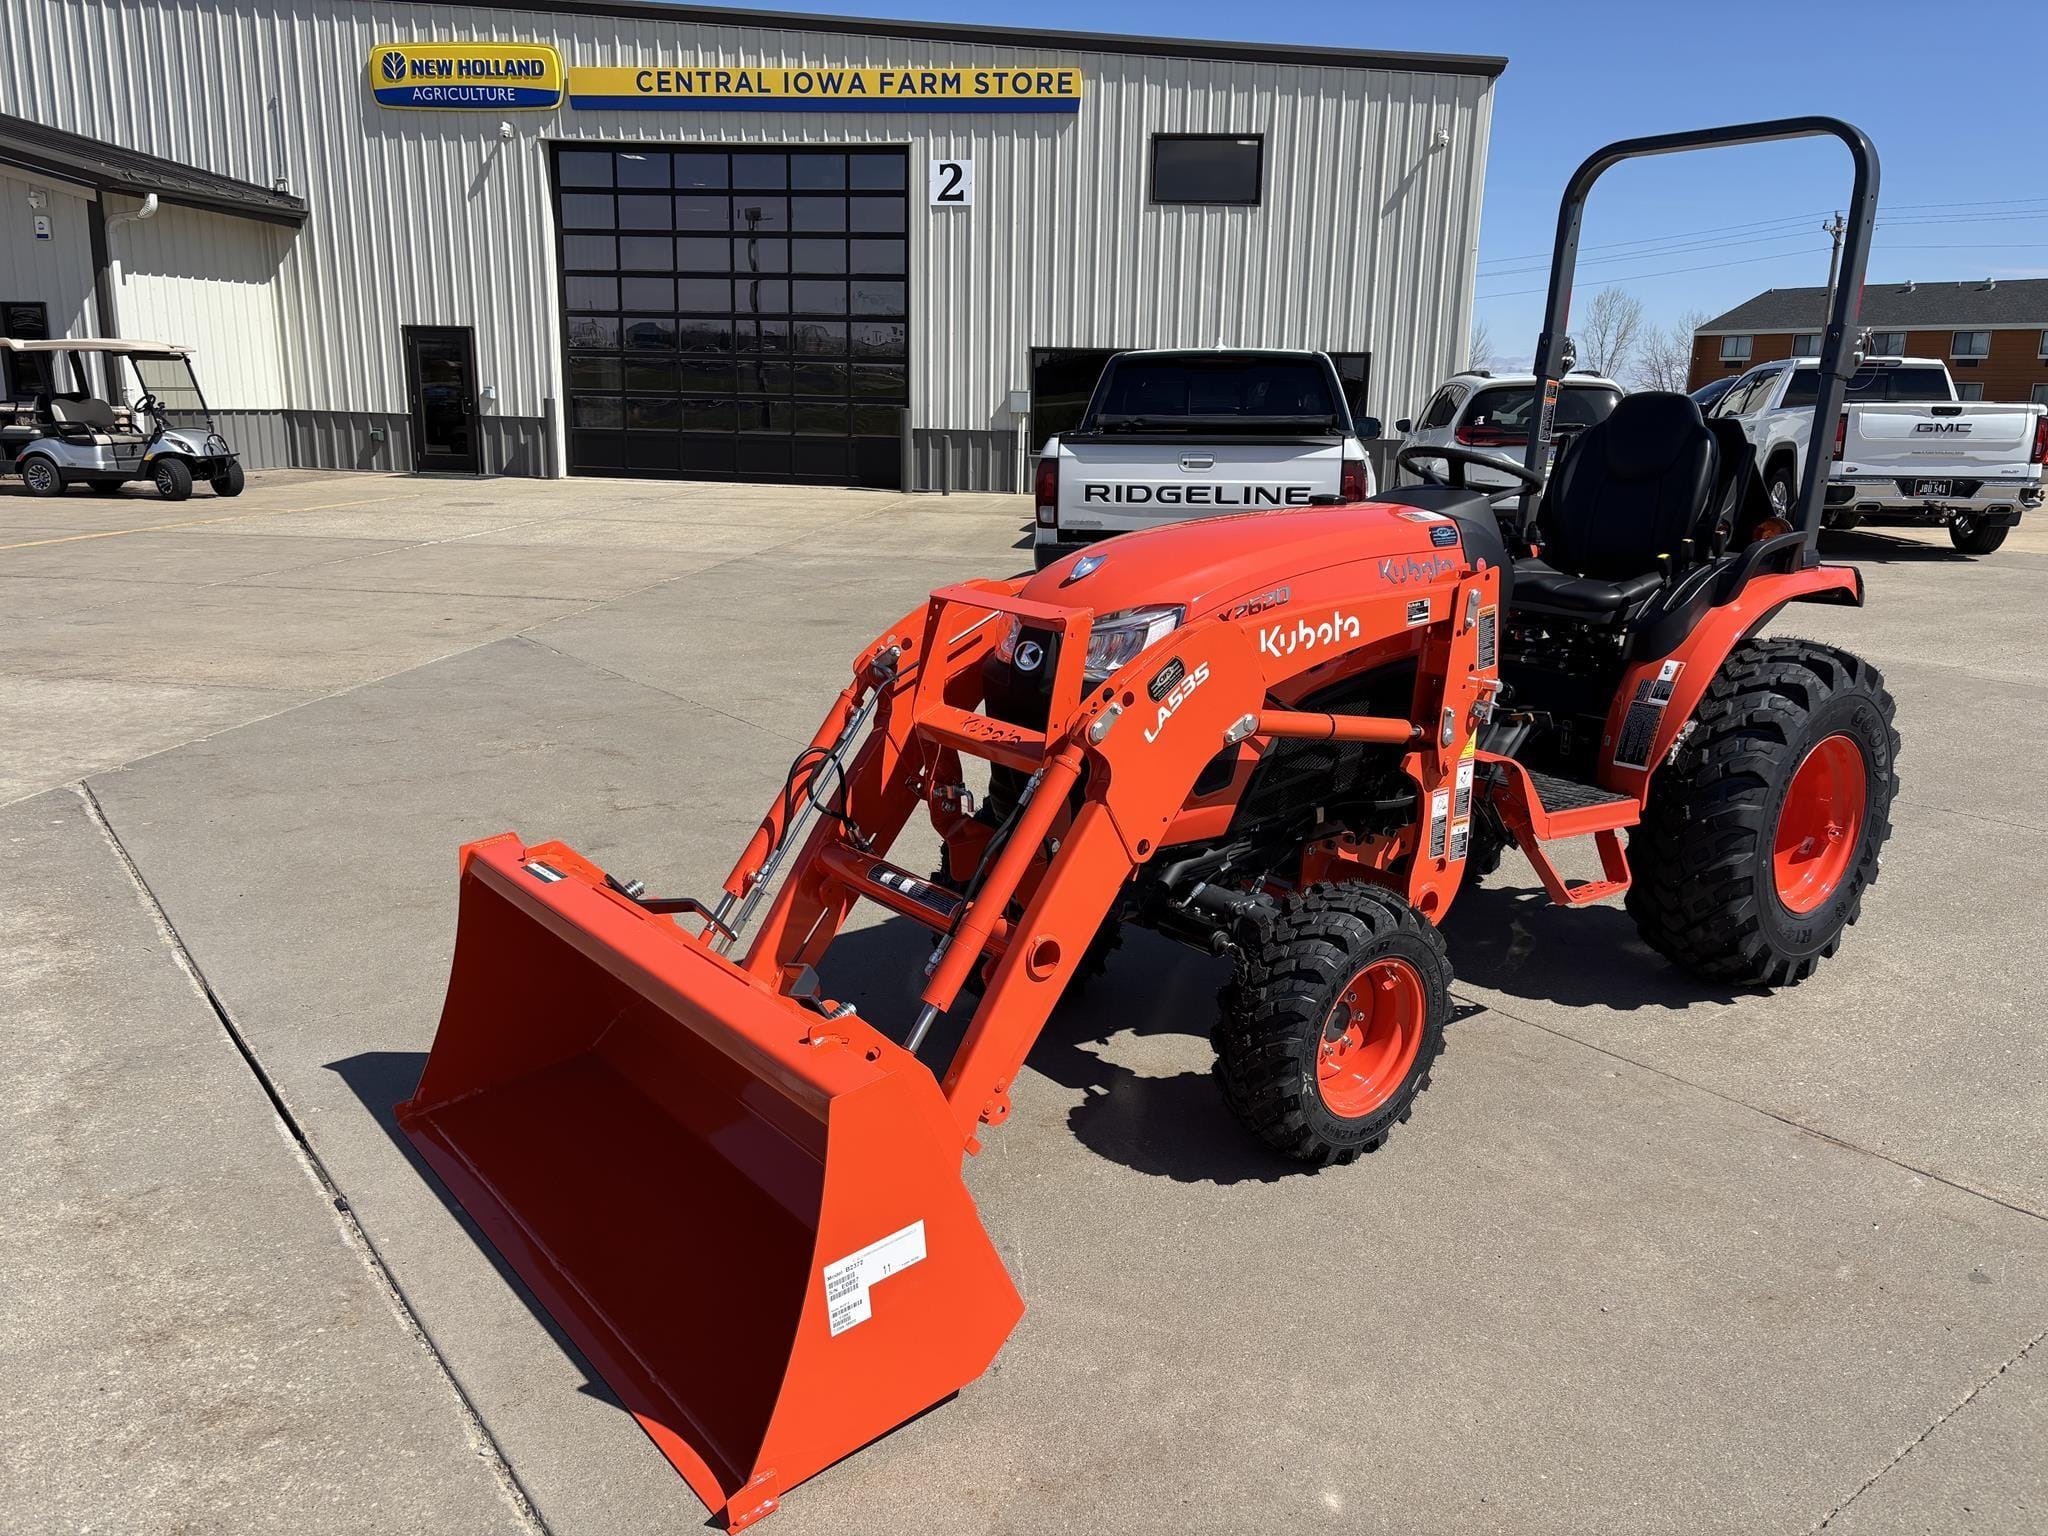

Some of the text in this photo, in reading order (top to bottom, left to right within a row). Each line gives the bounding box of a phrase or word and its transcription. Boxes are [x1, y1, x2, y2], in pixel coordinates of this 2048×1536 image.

[411, 59, 545, 79] NEW HOLLAND
[412, 87, 516, 101] AGRICULTURE
[636, 70, 1073, 95] CENTRAL IOWA FARM STORE
[937, 163, 965, 202] 2
[1916, 423, 1973, 433] GMC
[1084, 484, 1313, 506] RIDGELINE
[1934, 484, 1946, 493] 541
[1378, 553, 1455, 585] Kubota
[1259, 610, 1360, 658] Kubota
[1143, 661, 1210, 744] LA535
[1848, 704, 1889, 897] GOODYEAR
